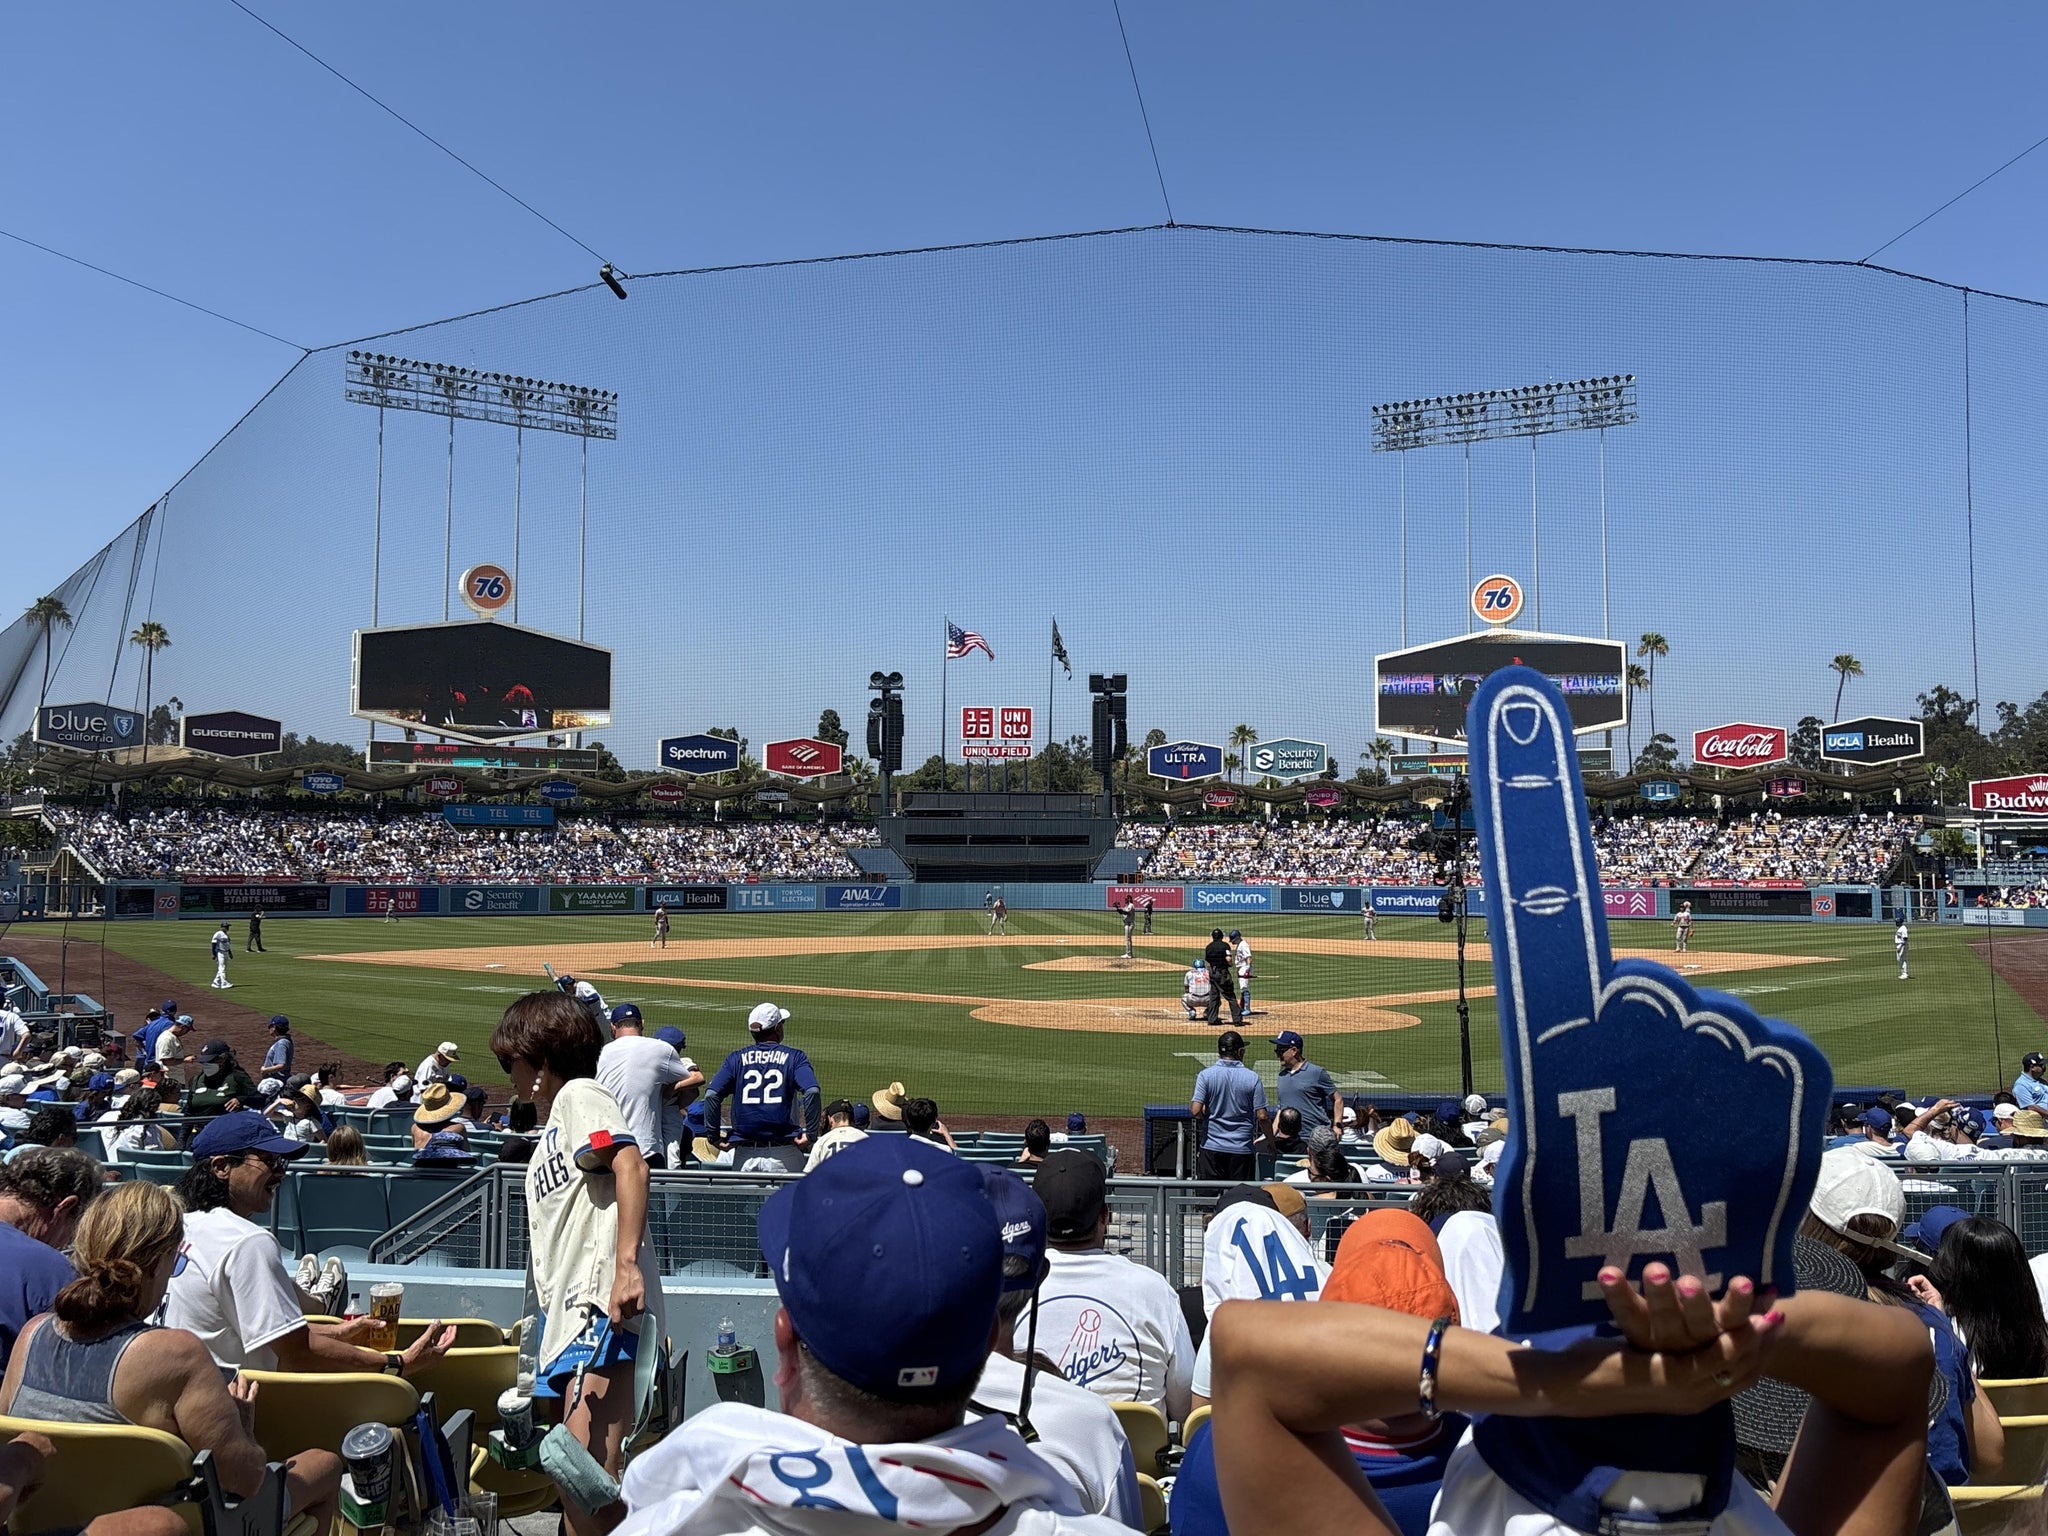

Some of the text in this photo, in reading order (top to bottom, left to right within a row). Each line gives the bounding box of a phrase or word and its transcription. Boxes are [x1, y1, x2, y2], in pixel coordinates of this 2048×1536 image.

[474, 576, 505, 599] 76
[1483, 587, 1513, 610] 76
[1566, 674, 1618, 687] FATHERS
[1382, 683, 1430, 694] FATHERS
[48, 710, 107, 732] blue
[967, 711, 990, 722] ユニ
[1004, 712, 1026, 722] UNI
[192, 728, 275, 740] GUGGENHEIM
[966, 724, 990, 734] クロ
[1004, 724, 1028, 736] QLO
[57, 733, 114, 744] california
[1829, 734, 1914, 748] UCLA Health
[1702, 733, 1777, 758] Coca-Cola
[669, 747, 727, 760] Spectrum
[966, 748, 998, 756] UNIQLO
[1165, 753, 1206, 763] ULTRA
[1278, 748, 1319, 760] Security
[1278, 759, 1313, 769] Benefit
[431, 781, 457, 792] JINRO
[1645, 784, 1673, 796] TEL
[1205, 793, 1234, 803] Churu
[456, 808, 542, 818] TEL TEL TEL
[398, 892, 416, 900] UNI
[487, 890, 524, 901] Security
[656, 893, 720, 904] UCLA Health
[739, 891, 774, 906] TEL
[840, 889, 870, 900] ANA
[1197, 891, 1262, 905] Spectrum
[1299, 891, 1330, 904] blue
[158, 896, 177, 908] 76
[398, 901, 417, 909] QLO
[487, 901, 520, 910] Benefit
[1816, 900, 1832, 911] 76
[741, 1050, 789, 1066] KERSHAW
[742, 1069, 783, 1104] 22
[546, 1126, 558, 1153] 17
[1558, 1087, 1728, 1300] LA
[1001, 1221, 1031, 1244] dgers
[1064, 1338, 1126, 1388] dgers
